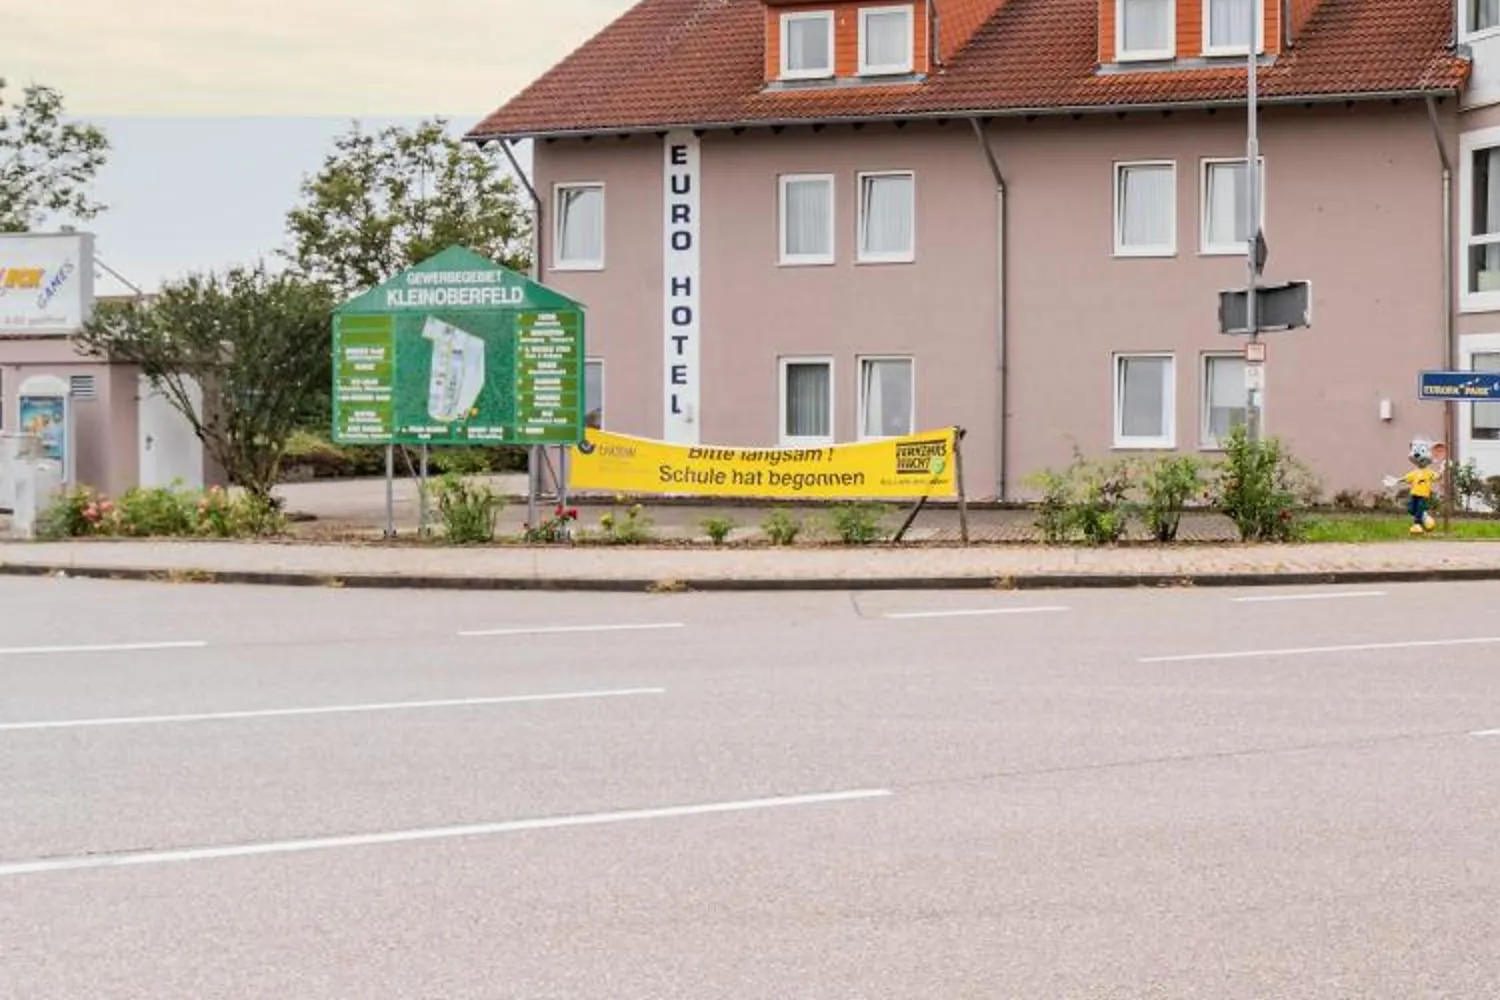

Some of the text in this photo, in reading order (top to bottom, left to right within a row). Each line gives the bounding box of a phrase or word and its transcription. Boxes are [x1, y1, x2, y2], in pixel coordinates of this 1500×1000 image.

[671, 145, 692, 414] EURO HOTEL
[387, 287, 524, 306] KLEINOBERFELD
[658, 465, 726, 485] Schule
[731, 469, 762, 486] hat
[768, 470, 865, 493] begonnen
